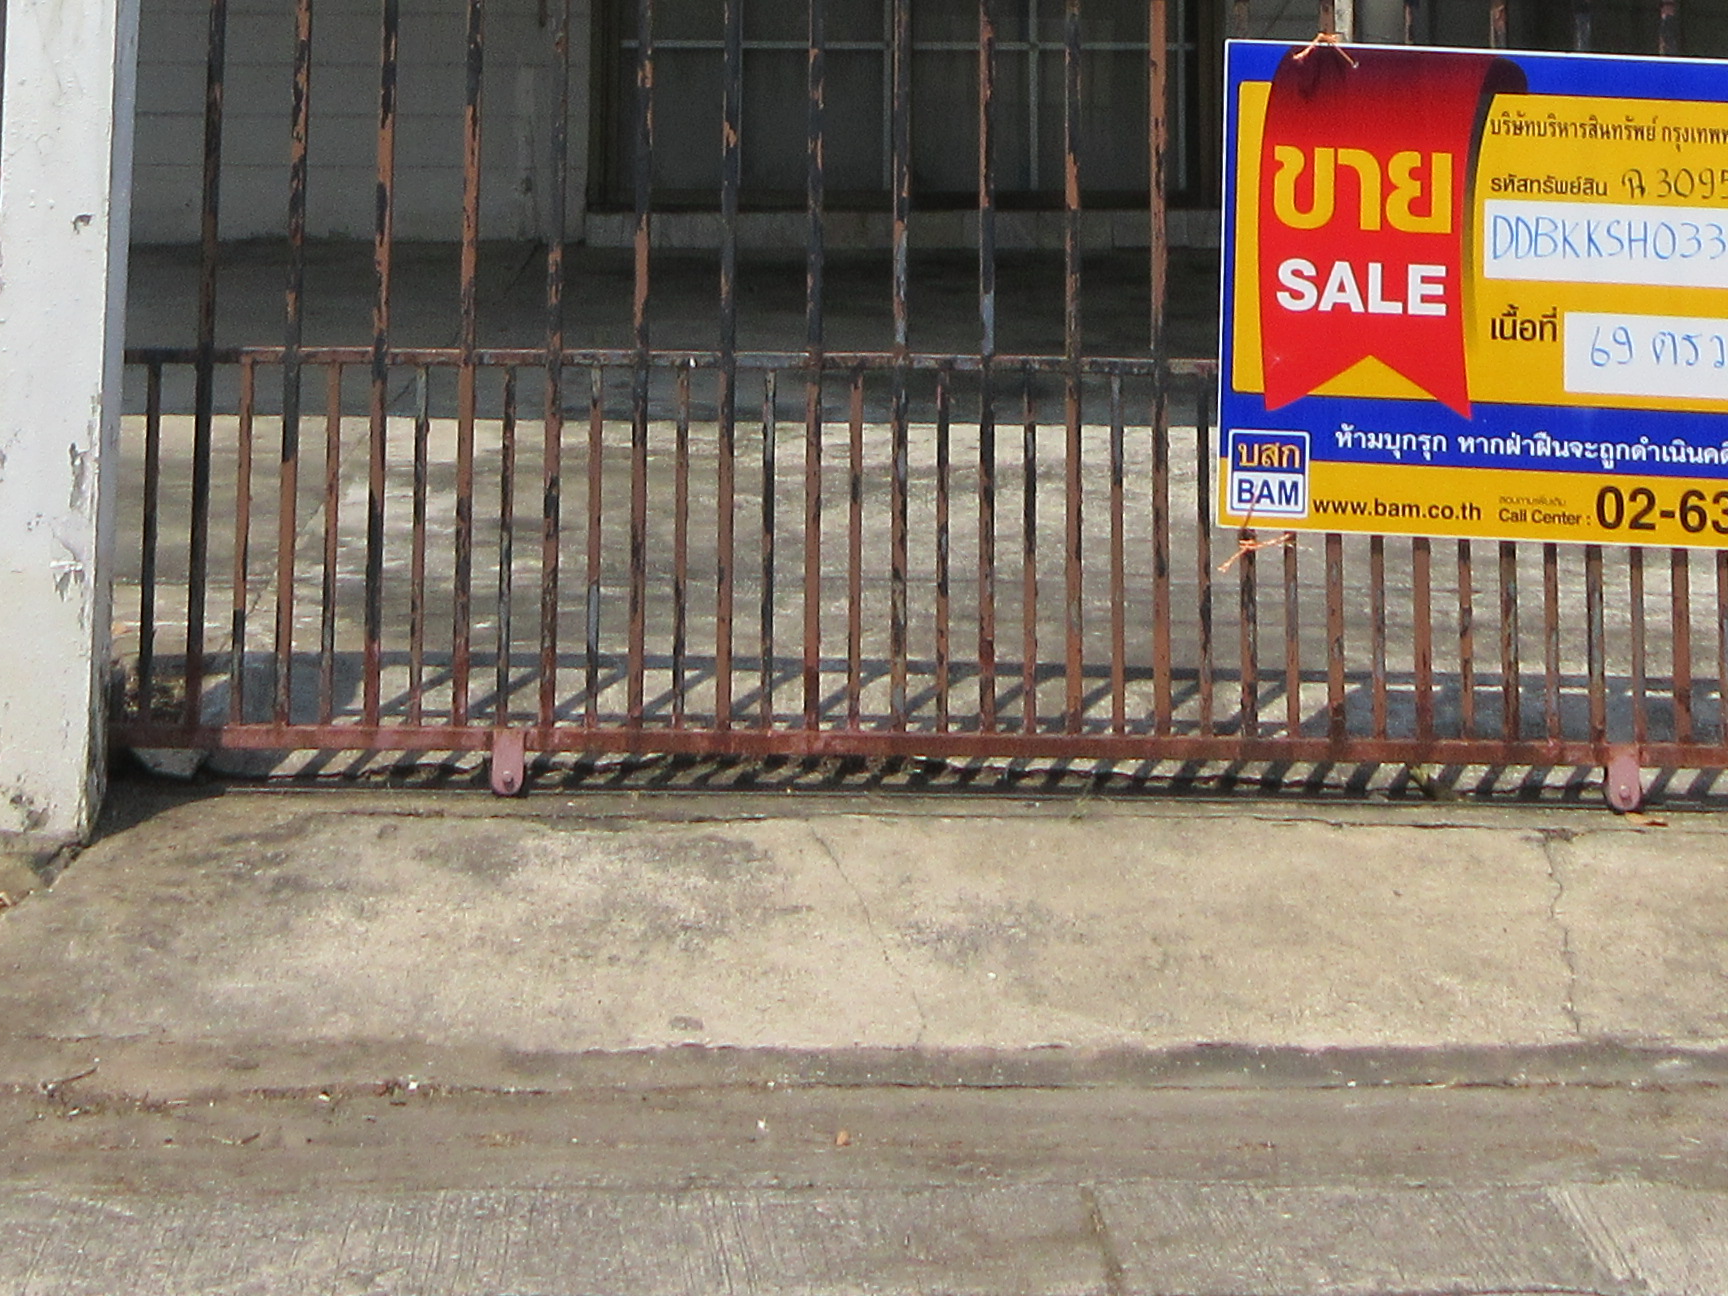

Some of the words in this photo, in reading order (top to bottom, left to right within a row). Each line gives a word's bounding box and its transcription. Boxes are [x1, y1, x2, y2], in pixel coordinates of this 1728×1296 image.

[1490, 111, 1658, 141] บริษัทบริหารสินทรัพย์
[1273, 145, 1452, 234] ขาย
[1490, 173, 1608, 196] รหัสทรัพย์สิน
[1276, 258, 1447, 316] SALE
[1490, 304, 1558, 342] เนื้อที่
[1589, 325, 1634, 367] 69
[1237, 442, 1301, 468] บสก
[1335, 423, 1447, 460] ห้ามบุกรุก
[1237, 478, 1300, 506] BAM
[1313, 498, 1482, 521] www.bam.co.th
[1498, 507, 1528, 523] Call
[1531, 509, 1583, 526] Center
